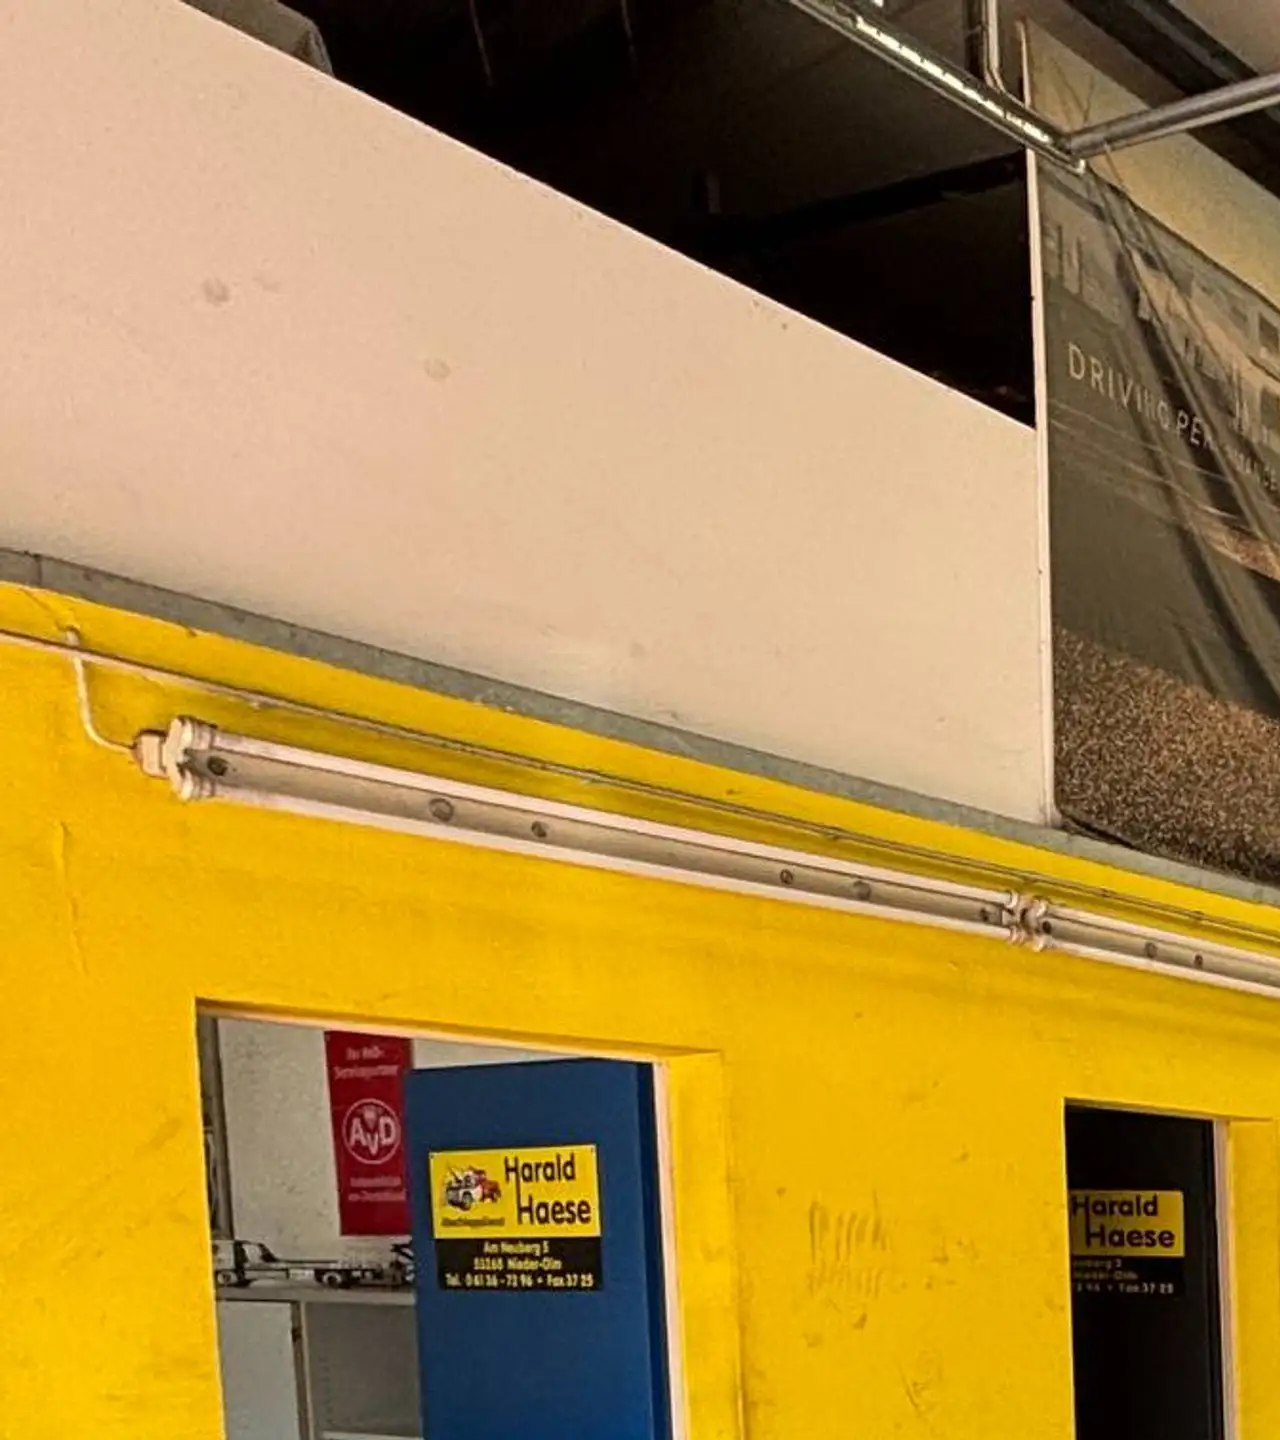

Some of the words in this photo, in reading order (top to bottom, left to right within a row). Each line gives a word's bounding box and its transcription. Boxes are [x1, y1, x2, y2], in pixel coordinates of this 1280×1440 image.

[350, 1117, 397, 1156] AvD
[504, 1153, 575, 1183] Harald
[517, 1193, 592, 1226] Haese
[1071, 1194, 1158, 1217] Harald
[1085, 1223, 1175, 1248] Haese
